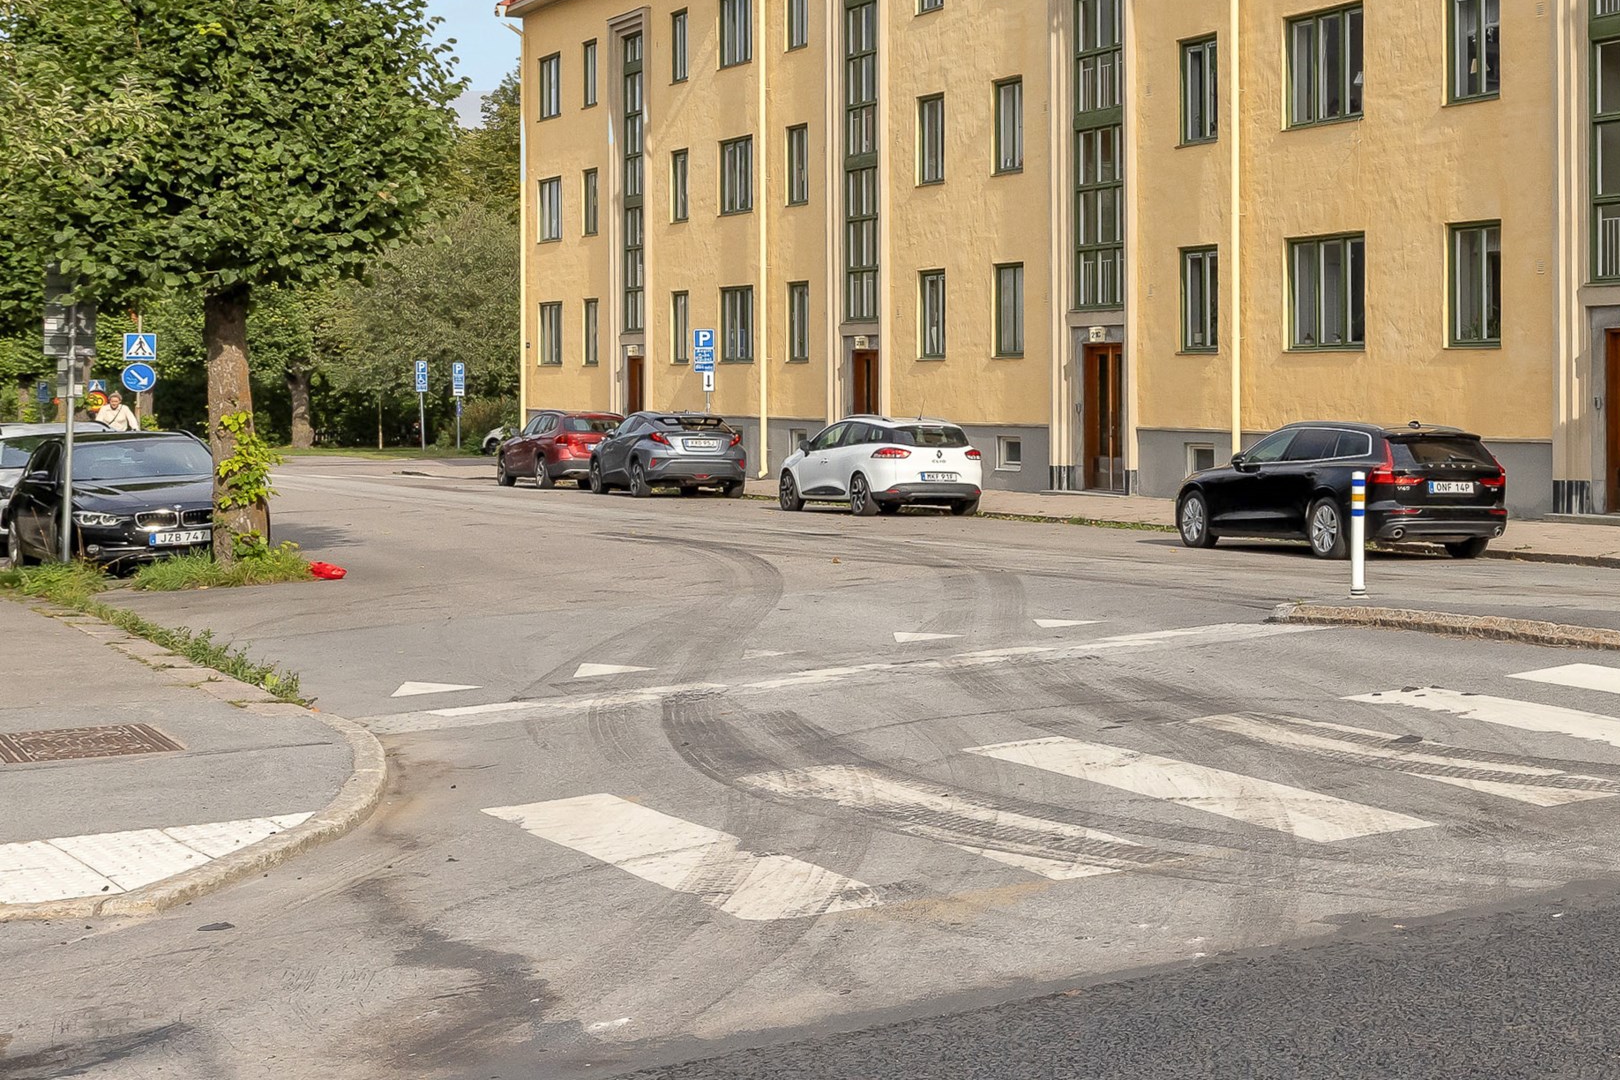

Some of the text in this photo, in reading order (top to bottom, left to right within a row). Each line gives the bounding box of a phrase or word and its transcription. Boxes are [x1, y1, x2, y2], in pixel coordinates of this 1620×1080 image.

[699, 331, 711, 347] P
[418, 362, 425, 372] P
[455, 364, 462, 374] P
[1436, 482, 1470, 492] ONF 14P
[160, 531, 206, 543] JZB 747
